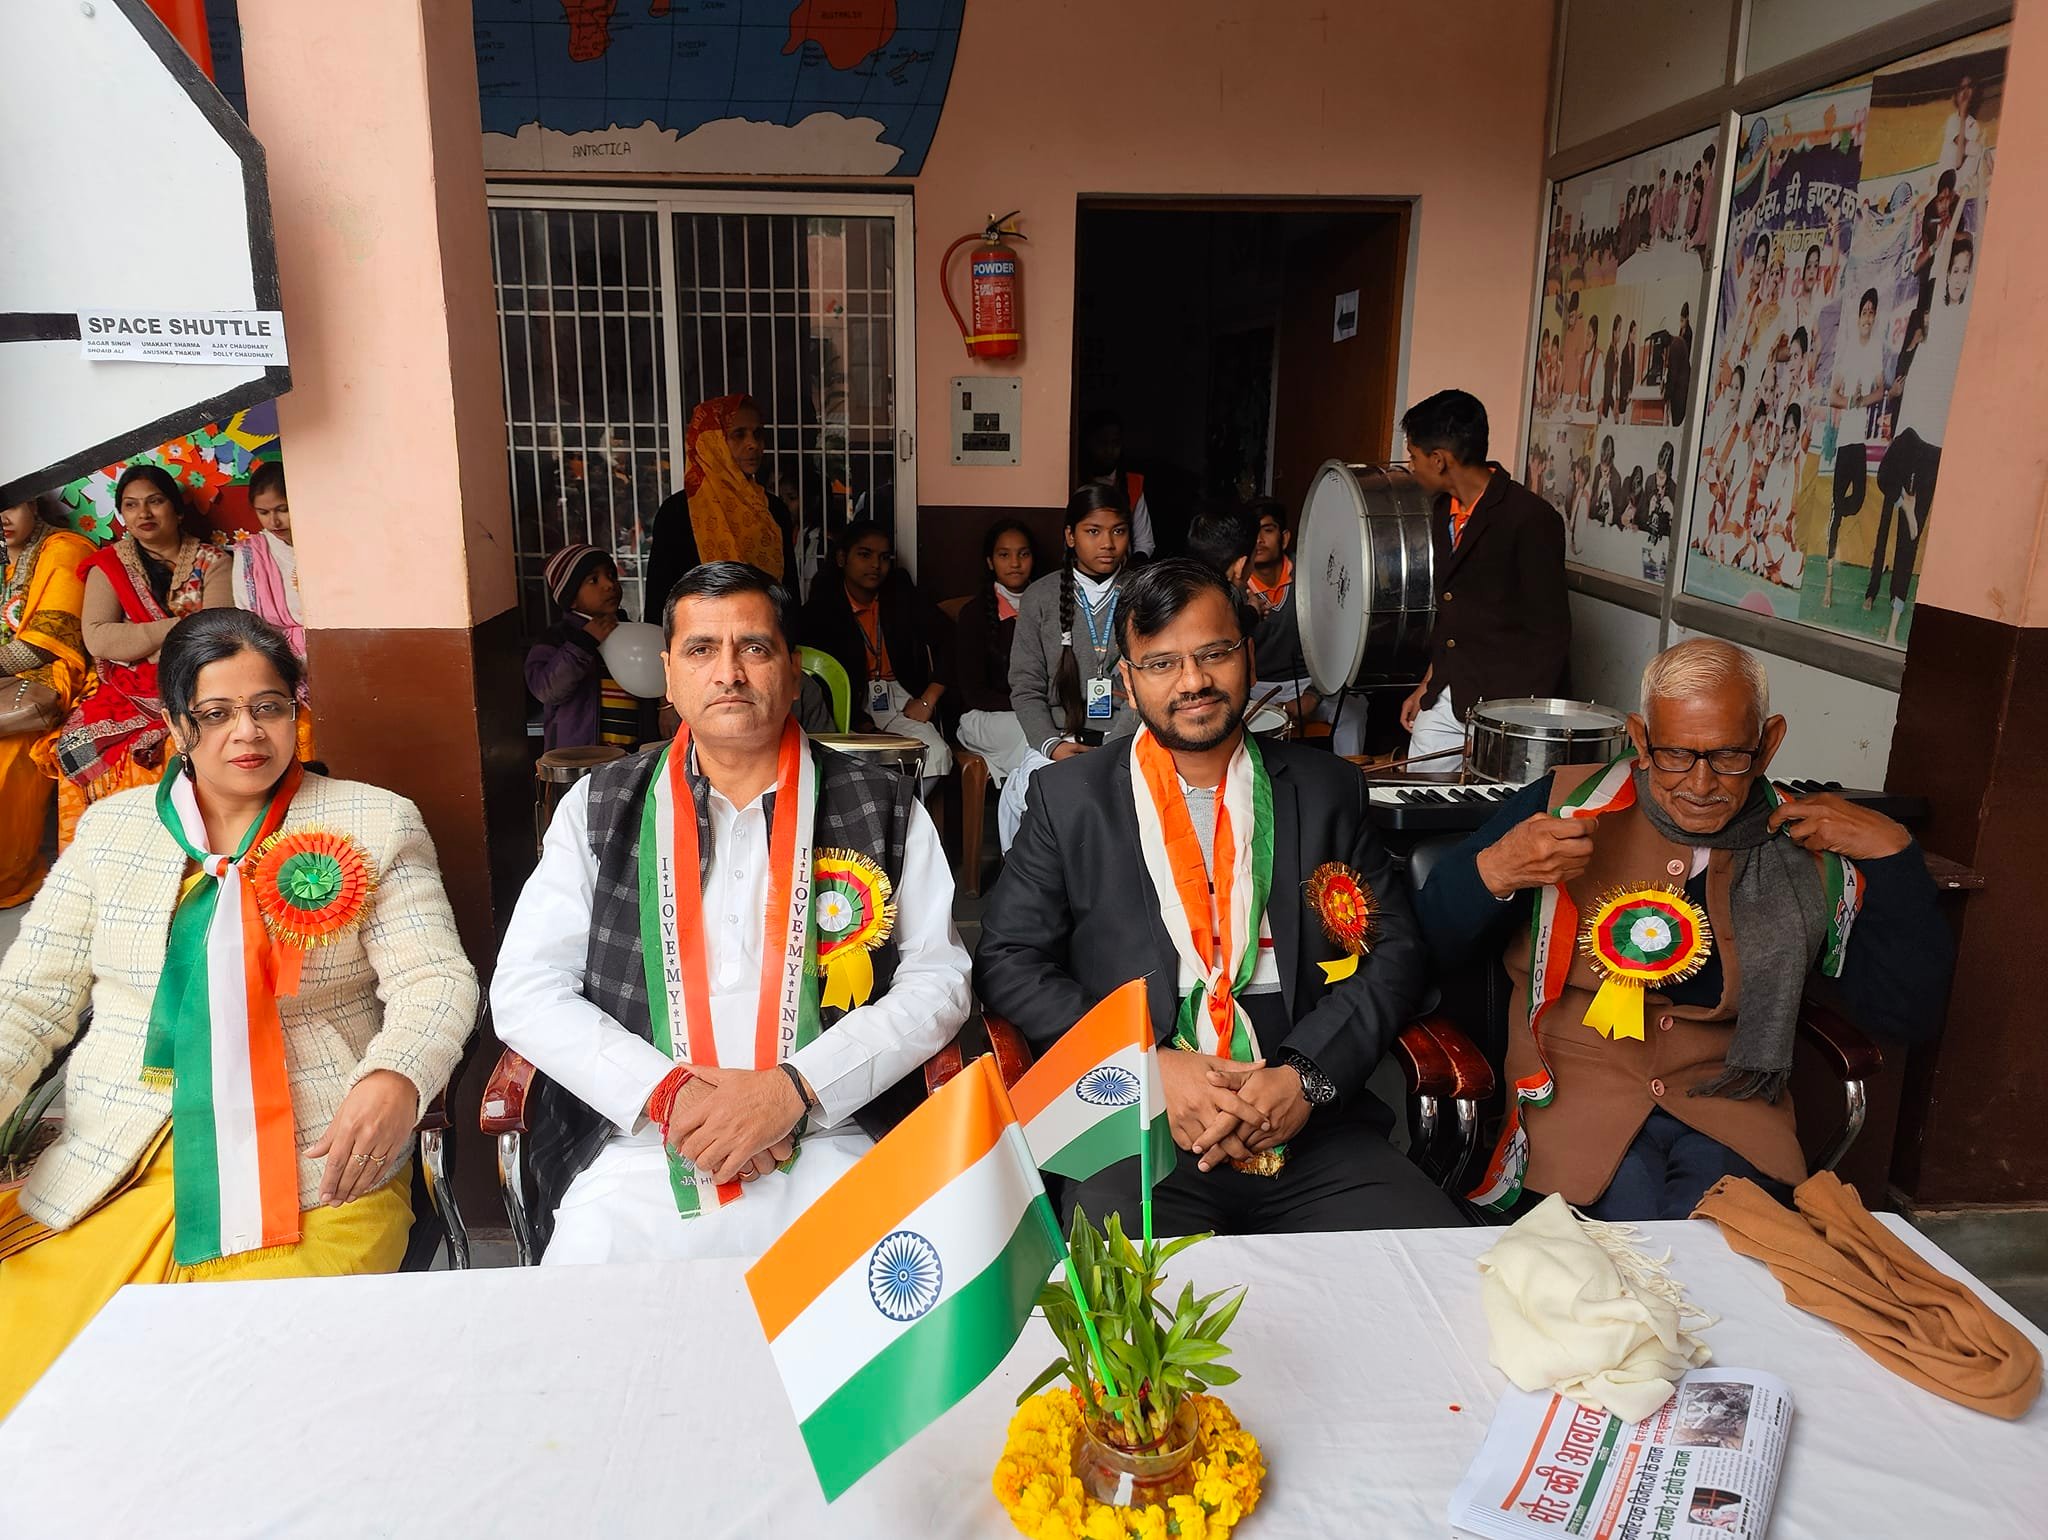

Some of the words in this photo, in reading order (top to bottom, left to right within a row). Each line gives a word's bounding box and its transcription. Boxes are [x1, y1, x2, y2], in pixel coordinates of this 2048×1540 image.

[973, 262, 1015, 275] POWDER
[88, 317, 162, 335] SPACE
[168, 319, 272, 337] SHUTTLE
[661, 857, 668, 871] I
[801, 847, 808, 860] I
[792, 870, 809, 934] LOVE
[662, 884, 676, 955] LOVE
[787, 943, 804, 977] MY
[665, 968, 681, 1005] MY
[782, 989, 798, 1060] INDI
[1554, 1404, 1607, 1466] आवाज
[1646, 1446, 1665, 1463] नाम
[1673, 1450, 1692, 1466] नाम
[1535, 1465, 1584, 1495] की
[1519, 1494, 1570, 1523] भोर
